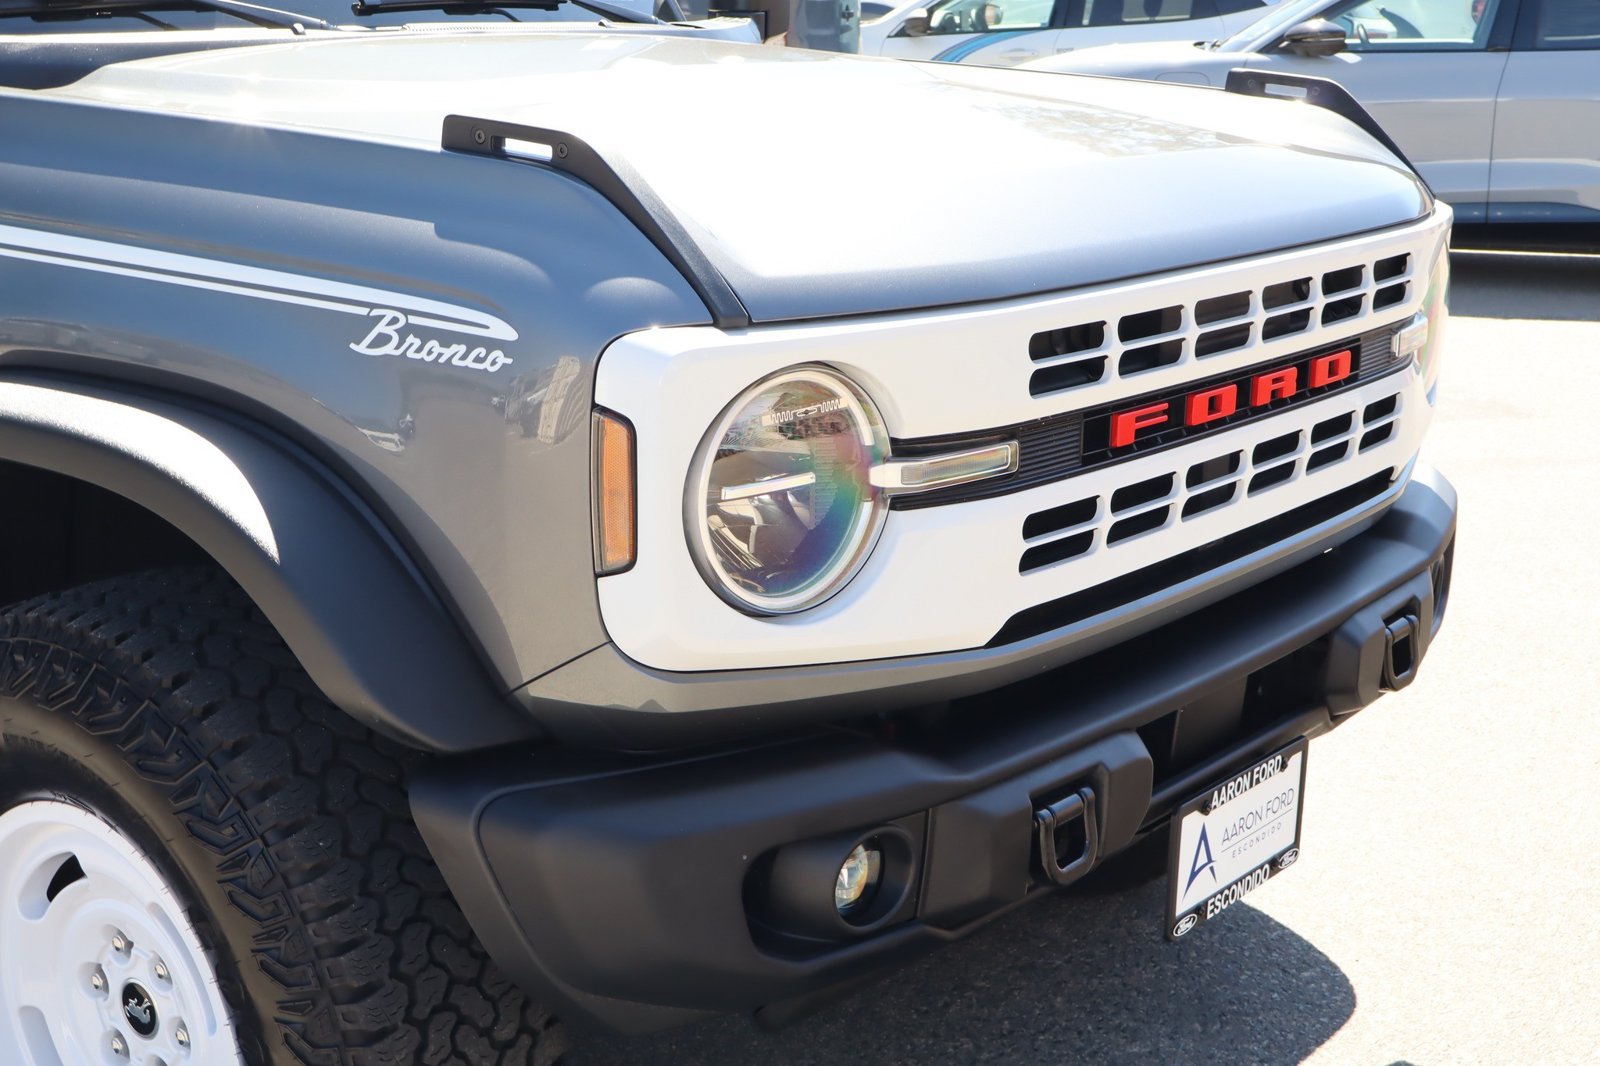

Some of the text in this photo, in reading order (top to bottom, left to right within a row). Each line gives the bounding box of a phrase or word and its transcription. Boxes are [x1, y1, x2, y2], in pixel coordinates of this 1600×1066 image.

[349, 308, 513, 372] Bronco
[1110, 350, 1352, 448] FORD
[1210, 755, 1282, 810] AARON FORD
[1222, 788, 1295, 846] AARON FORD
[1232, 822, 1282, 858] ESCONDIDO
[1207, 863, 1270, 920] ESCONDIDO
